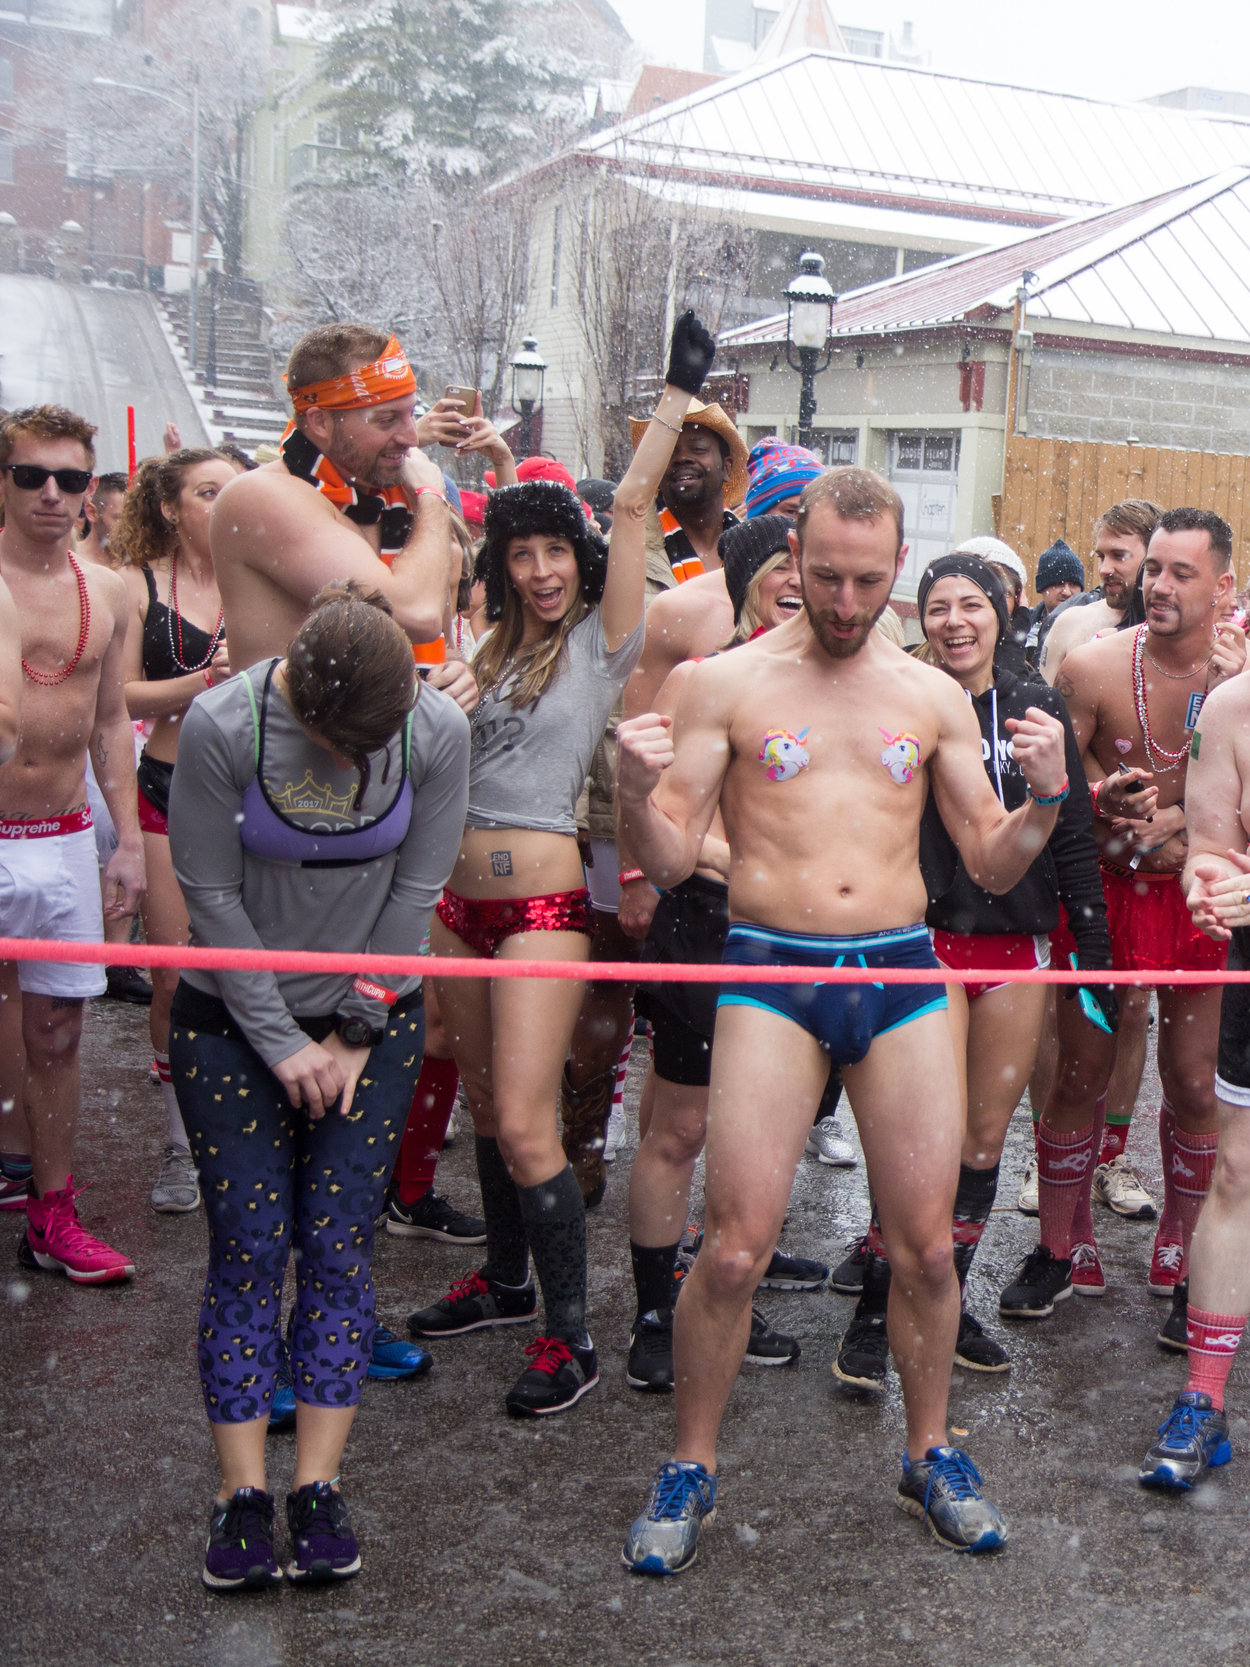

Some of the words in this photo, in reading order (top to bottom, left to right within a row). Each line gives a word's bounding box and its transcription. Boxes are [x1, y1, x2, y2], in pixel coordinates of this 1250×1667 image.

[296, 800, 319, 809] 2017
[493, 852, 509, 861] END
[494, 862, 511, 875] NF
[1098, 859, 1135, 879] PUMA
